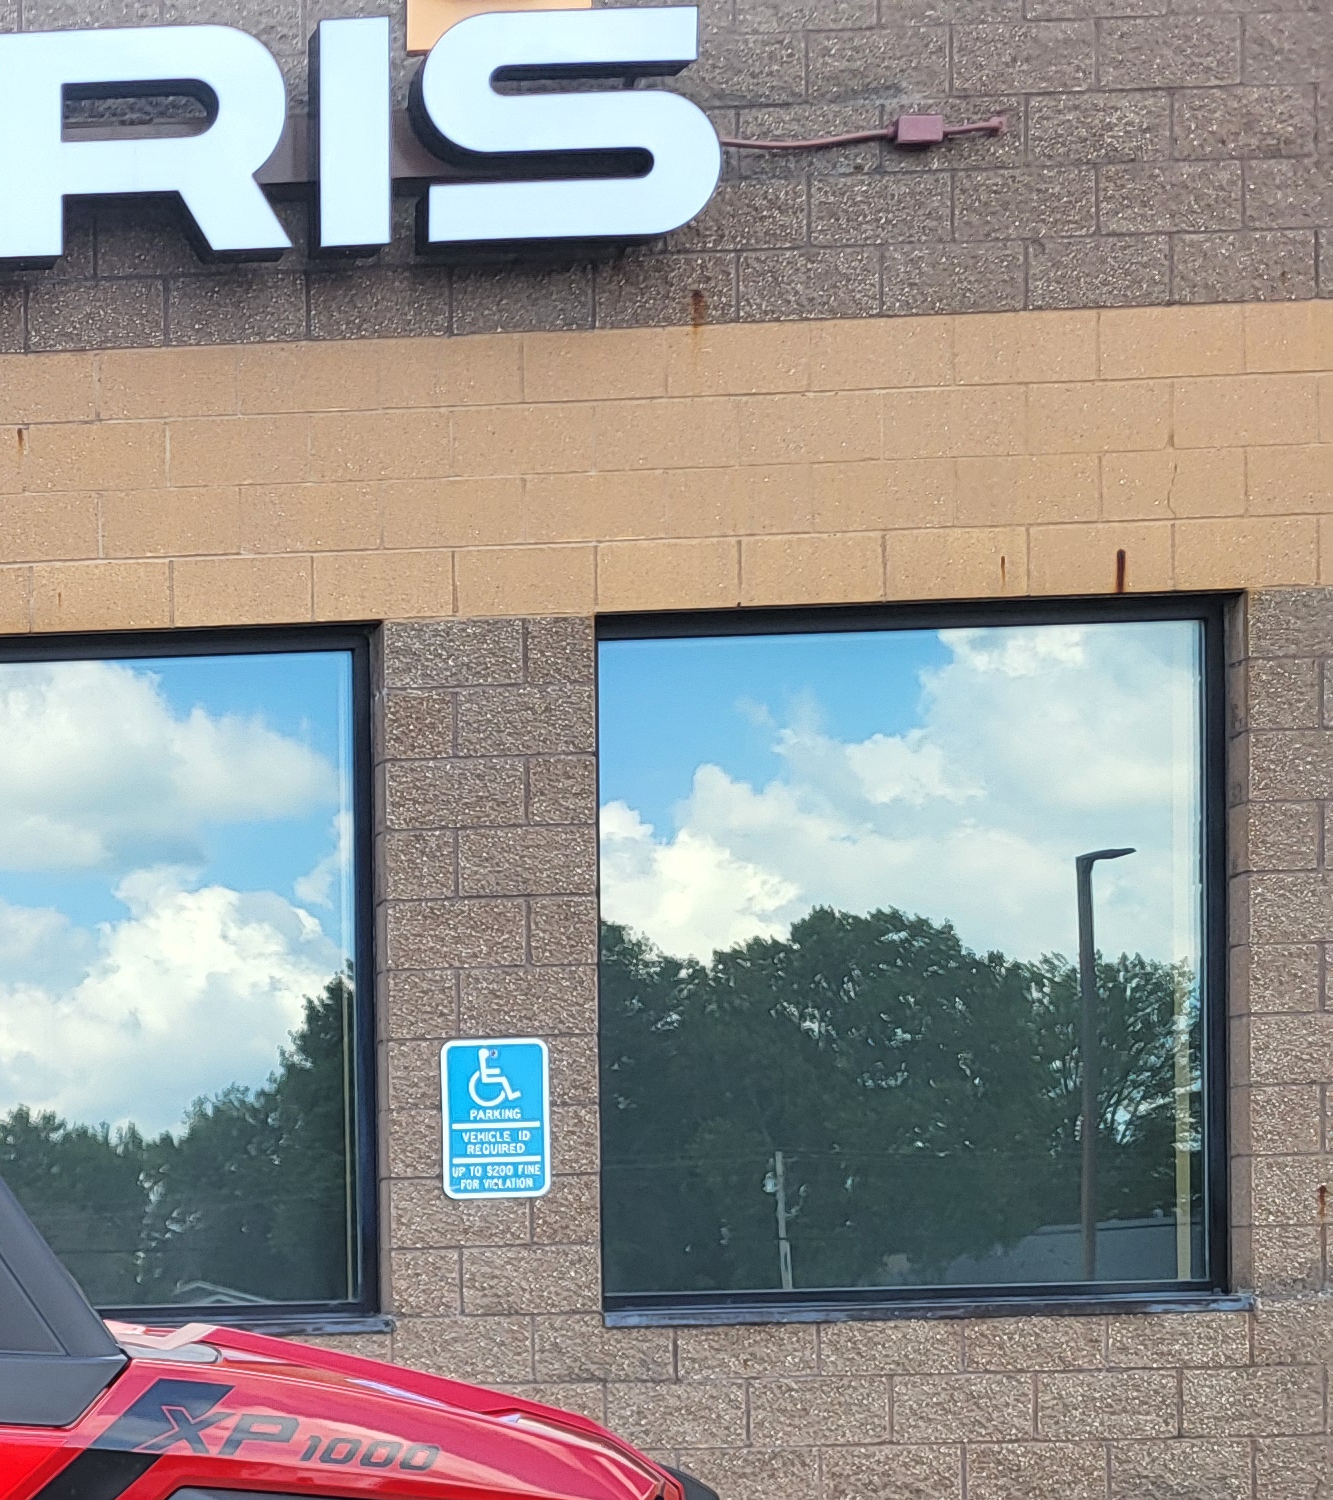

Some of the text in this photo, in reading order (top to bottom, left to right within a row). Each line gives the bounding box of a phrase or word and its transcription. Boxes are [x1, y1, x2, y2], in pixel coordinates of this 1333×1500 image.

[469, 1108, 521, 1120] PARKING
[462, 1130, 531, 1142] VEHICLE ID
[467, 1143, 525, 1154] REQUIRED
[452, 1164, 541, 1178] UP TO $200 FINE
[460, 1177, 533, 1190] FOR VIOLATION
